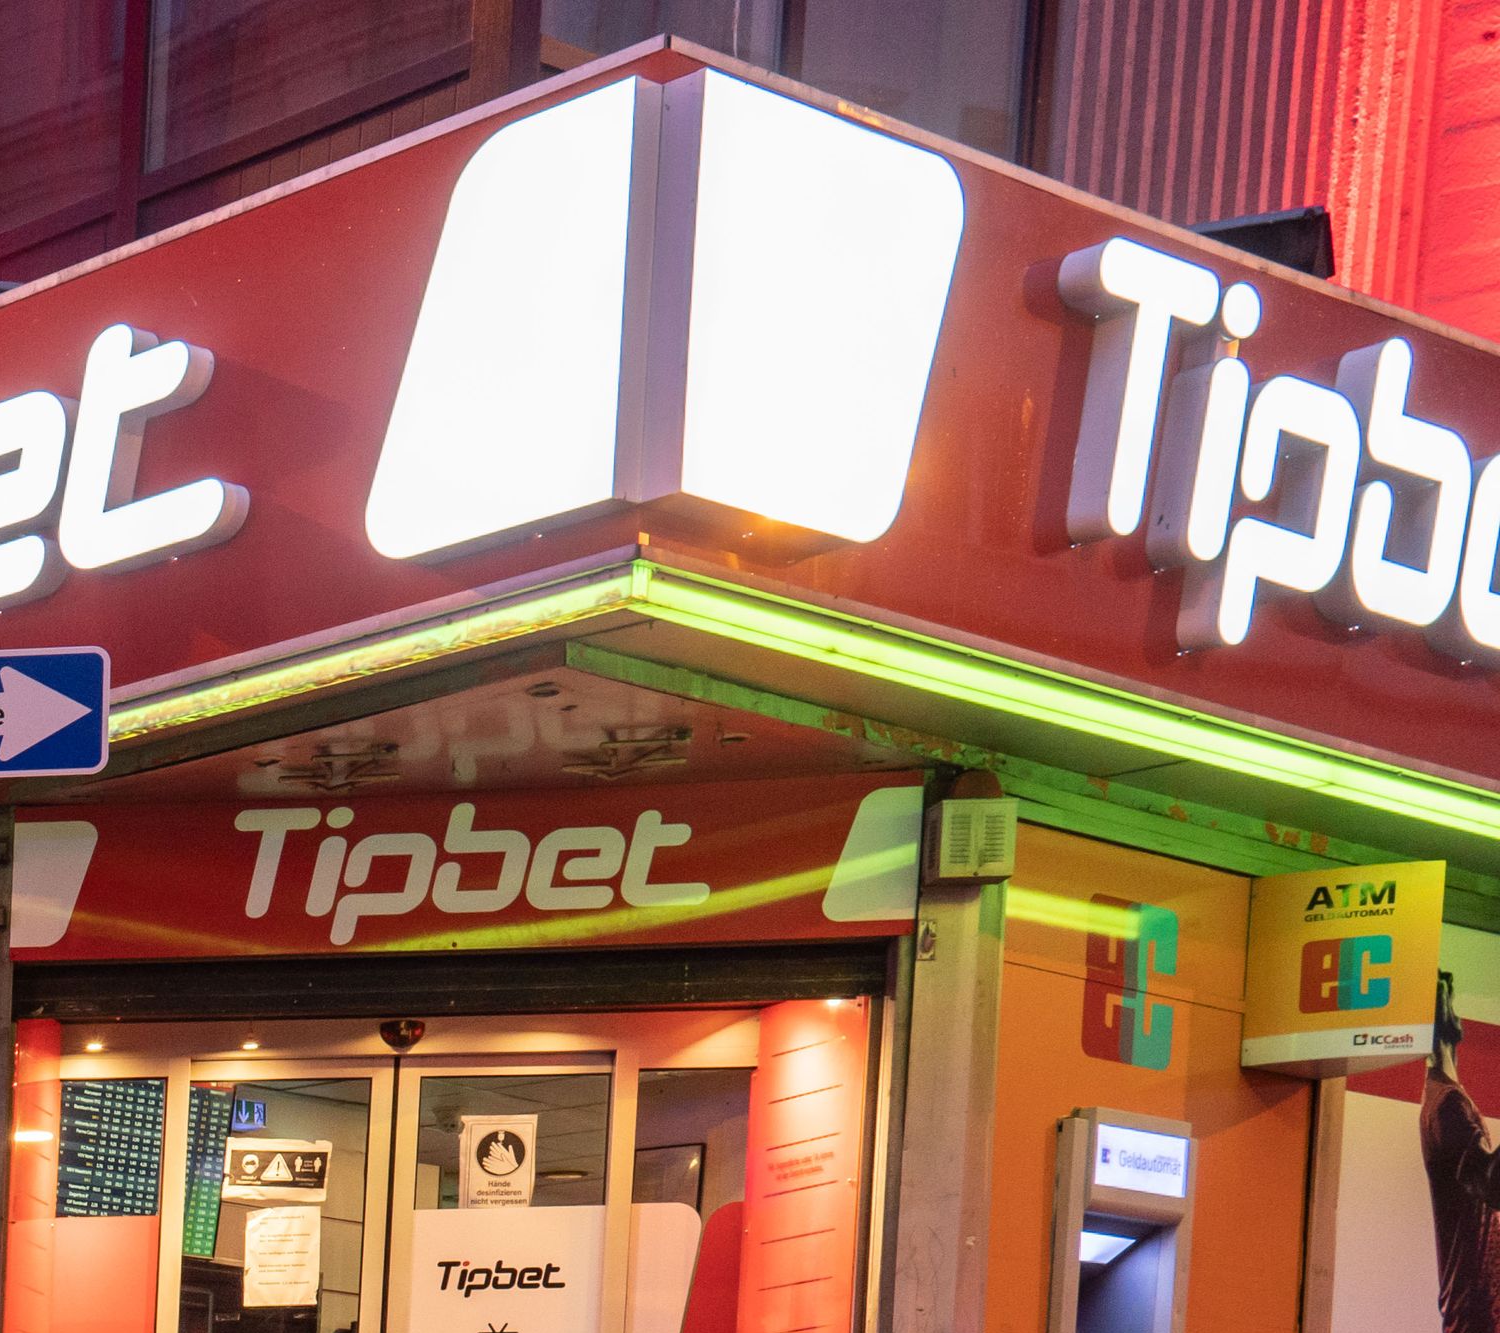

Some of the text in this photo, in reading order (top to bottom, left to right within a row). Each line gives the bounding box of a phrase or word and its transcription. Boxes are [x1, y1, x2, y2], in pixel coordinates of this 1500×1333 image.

[1057, 236, 1500, 652] Tipb
[233, 801, 711, 947] Tipbet
[1305, 879, 1397, 911] ATM
[1303, 907, 1396, 923] GELDAUTOMAT
[470, 1197, 528, 1206] nicht vergessen
[476, 1188, 522, 1197] desinfizieren
[437, 1259, 566, 1298] Tipbet
